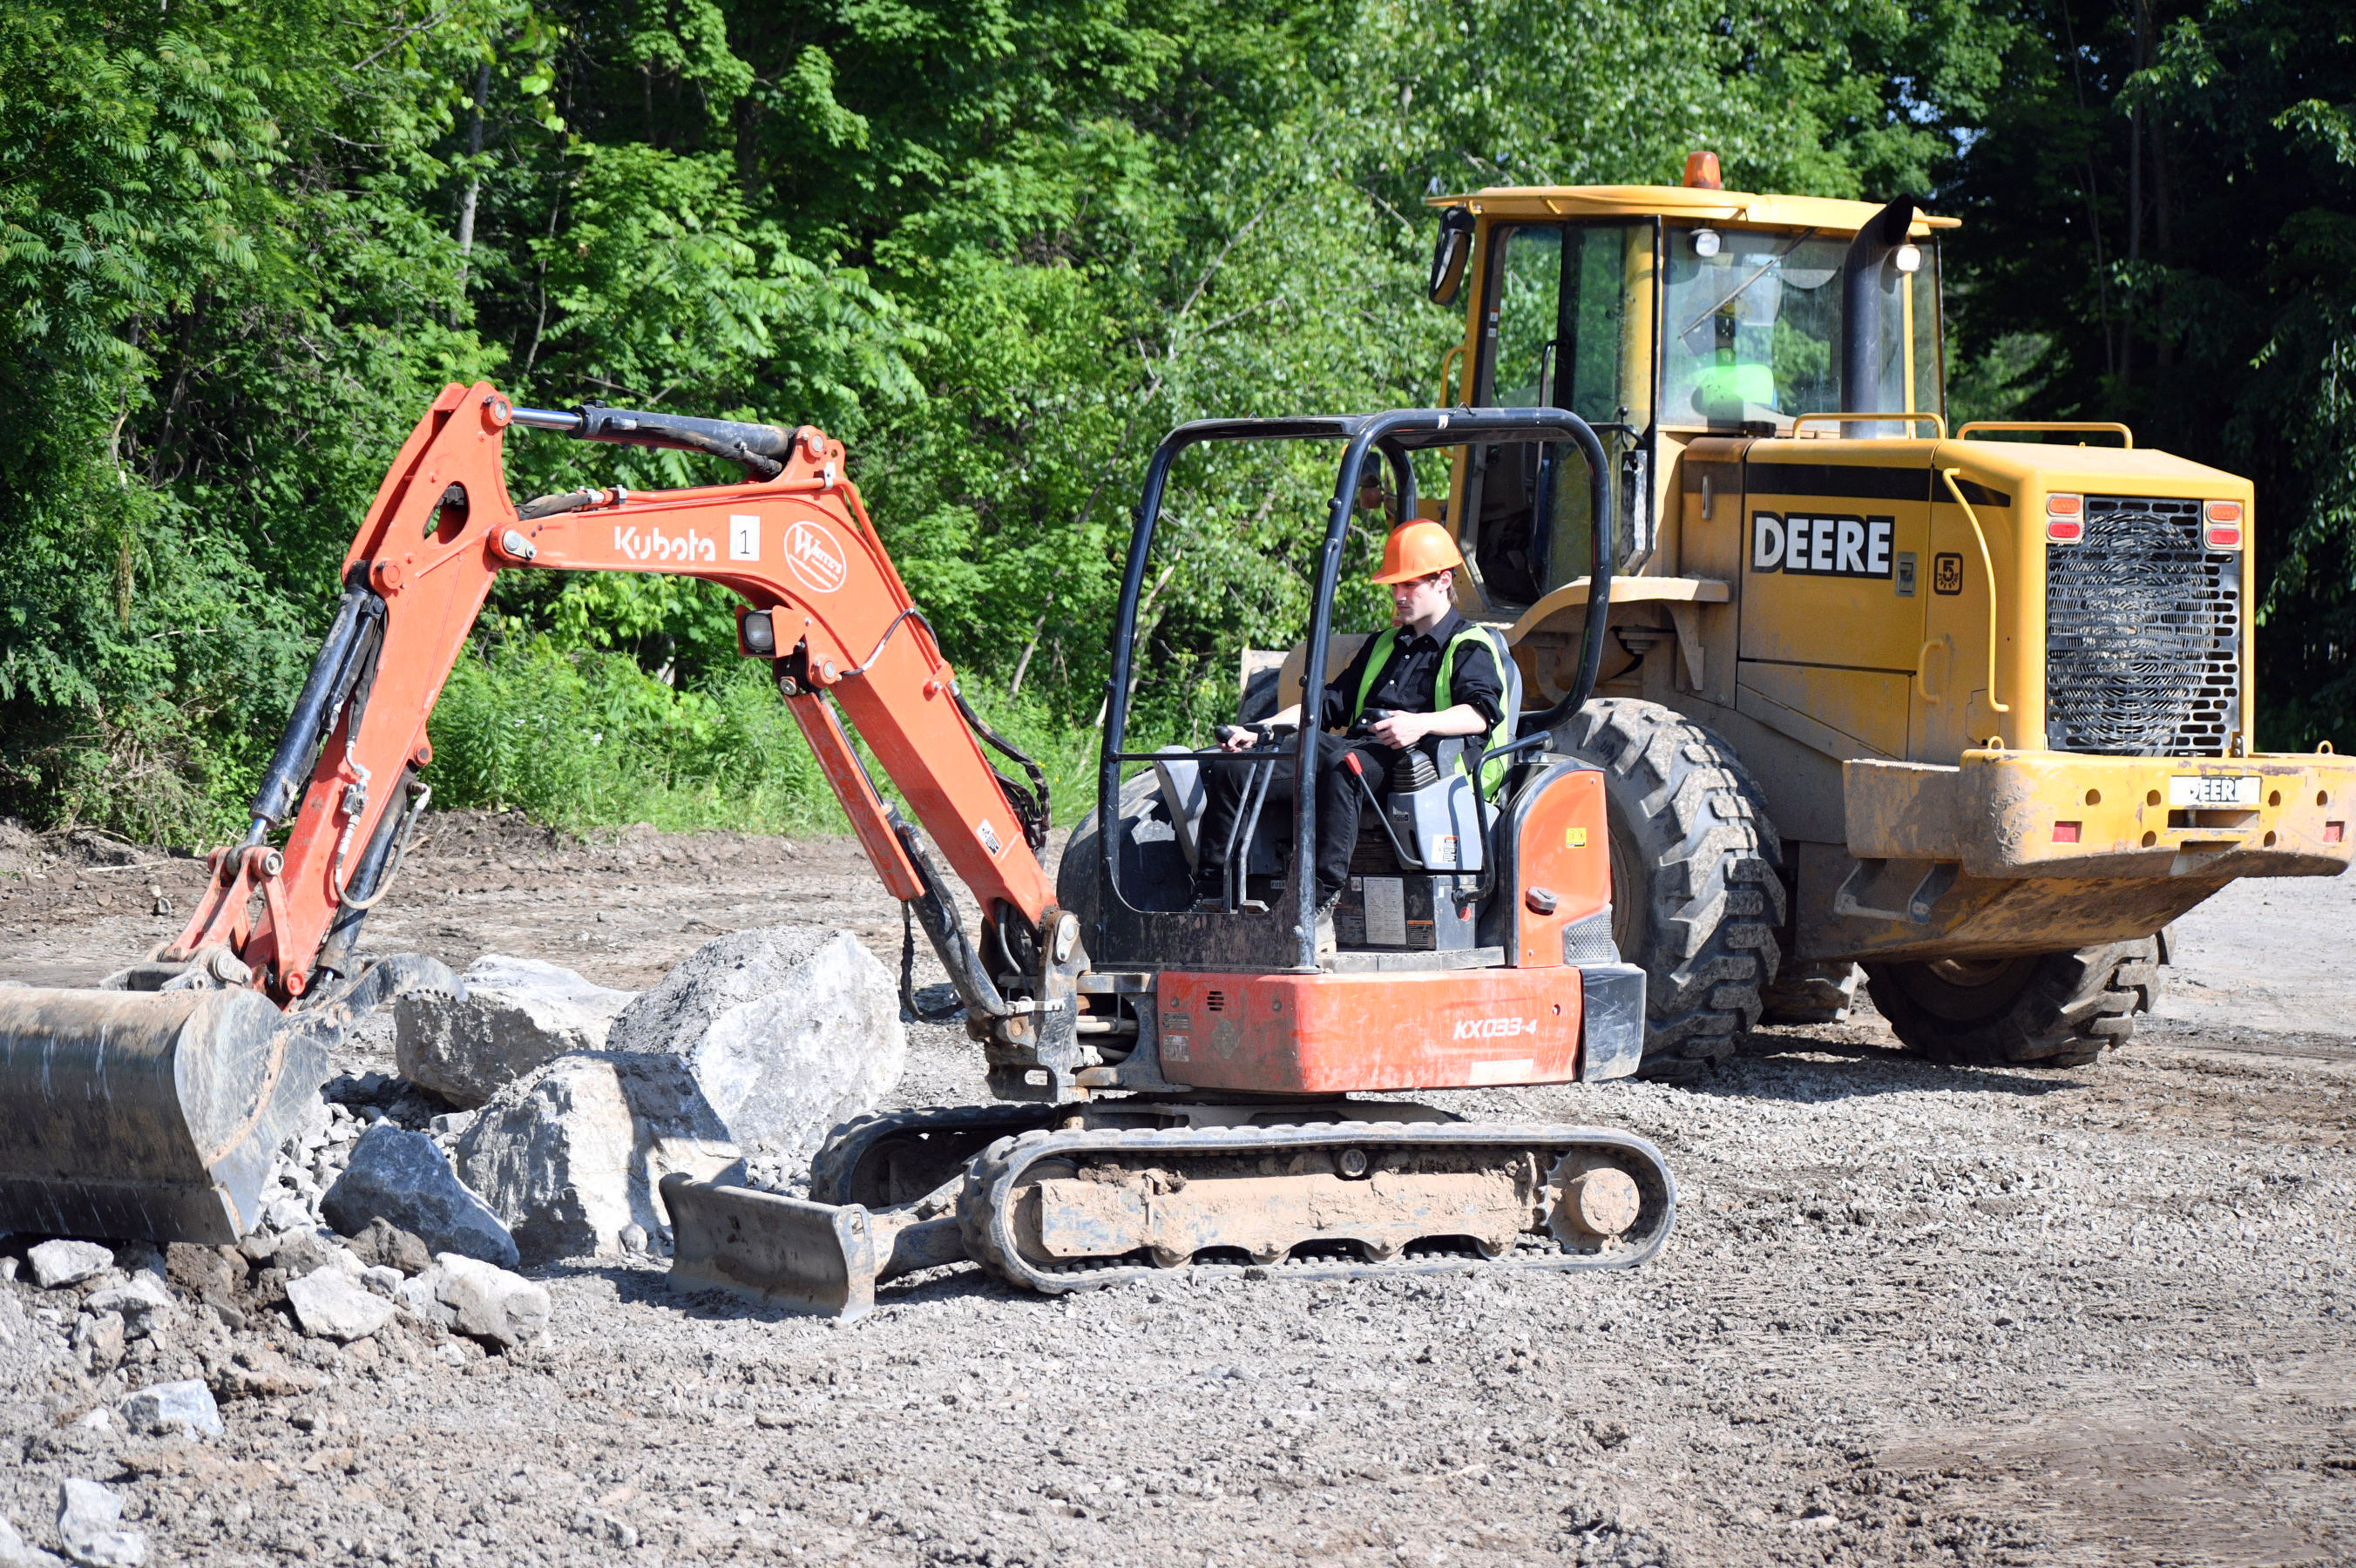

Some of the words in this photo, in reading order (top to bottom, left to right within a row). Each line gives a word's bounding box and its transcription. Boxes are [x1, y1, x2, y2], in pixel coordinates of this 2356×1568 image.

[614, 526, 715, 561] Kubota
[739, 530, 750, 554] 1
[1754, 517, 1892, 573] DEERE
[1943, 560, 1954, 582] 5
[1453, 1017, 1537, 1038] KX033-4
